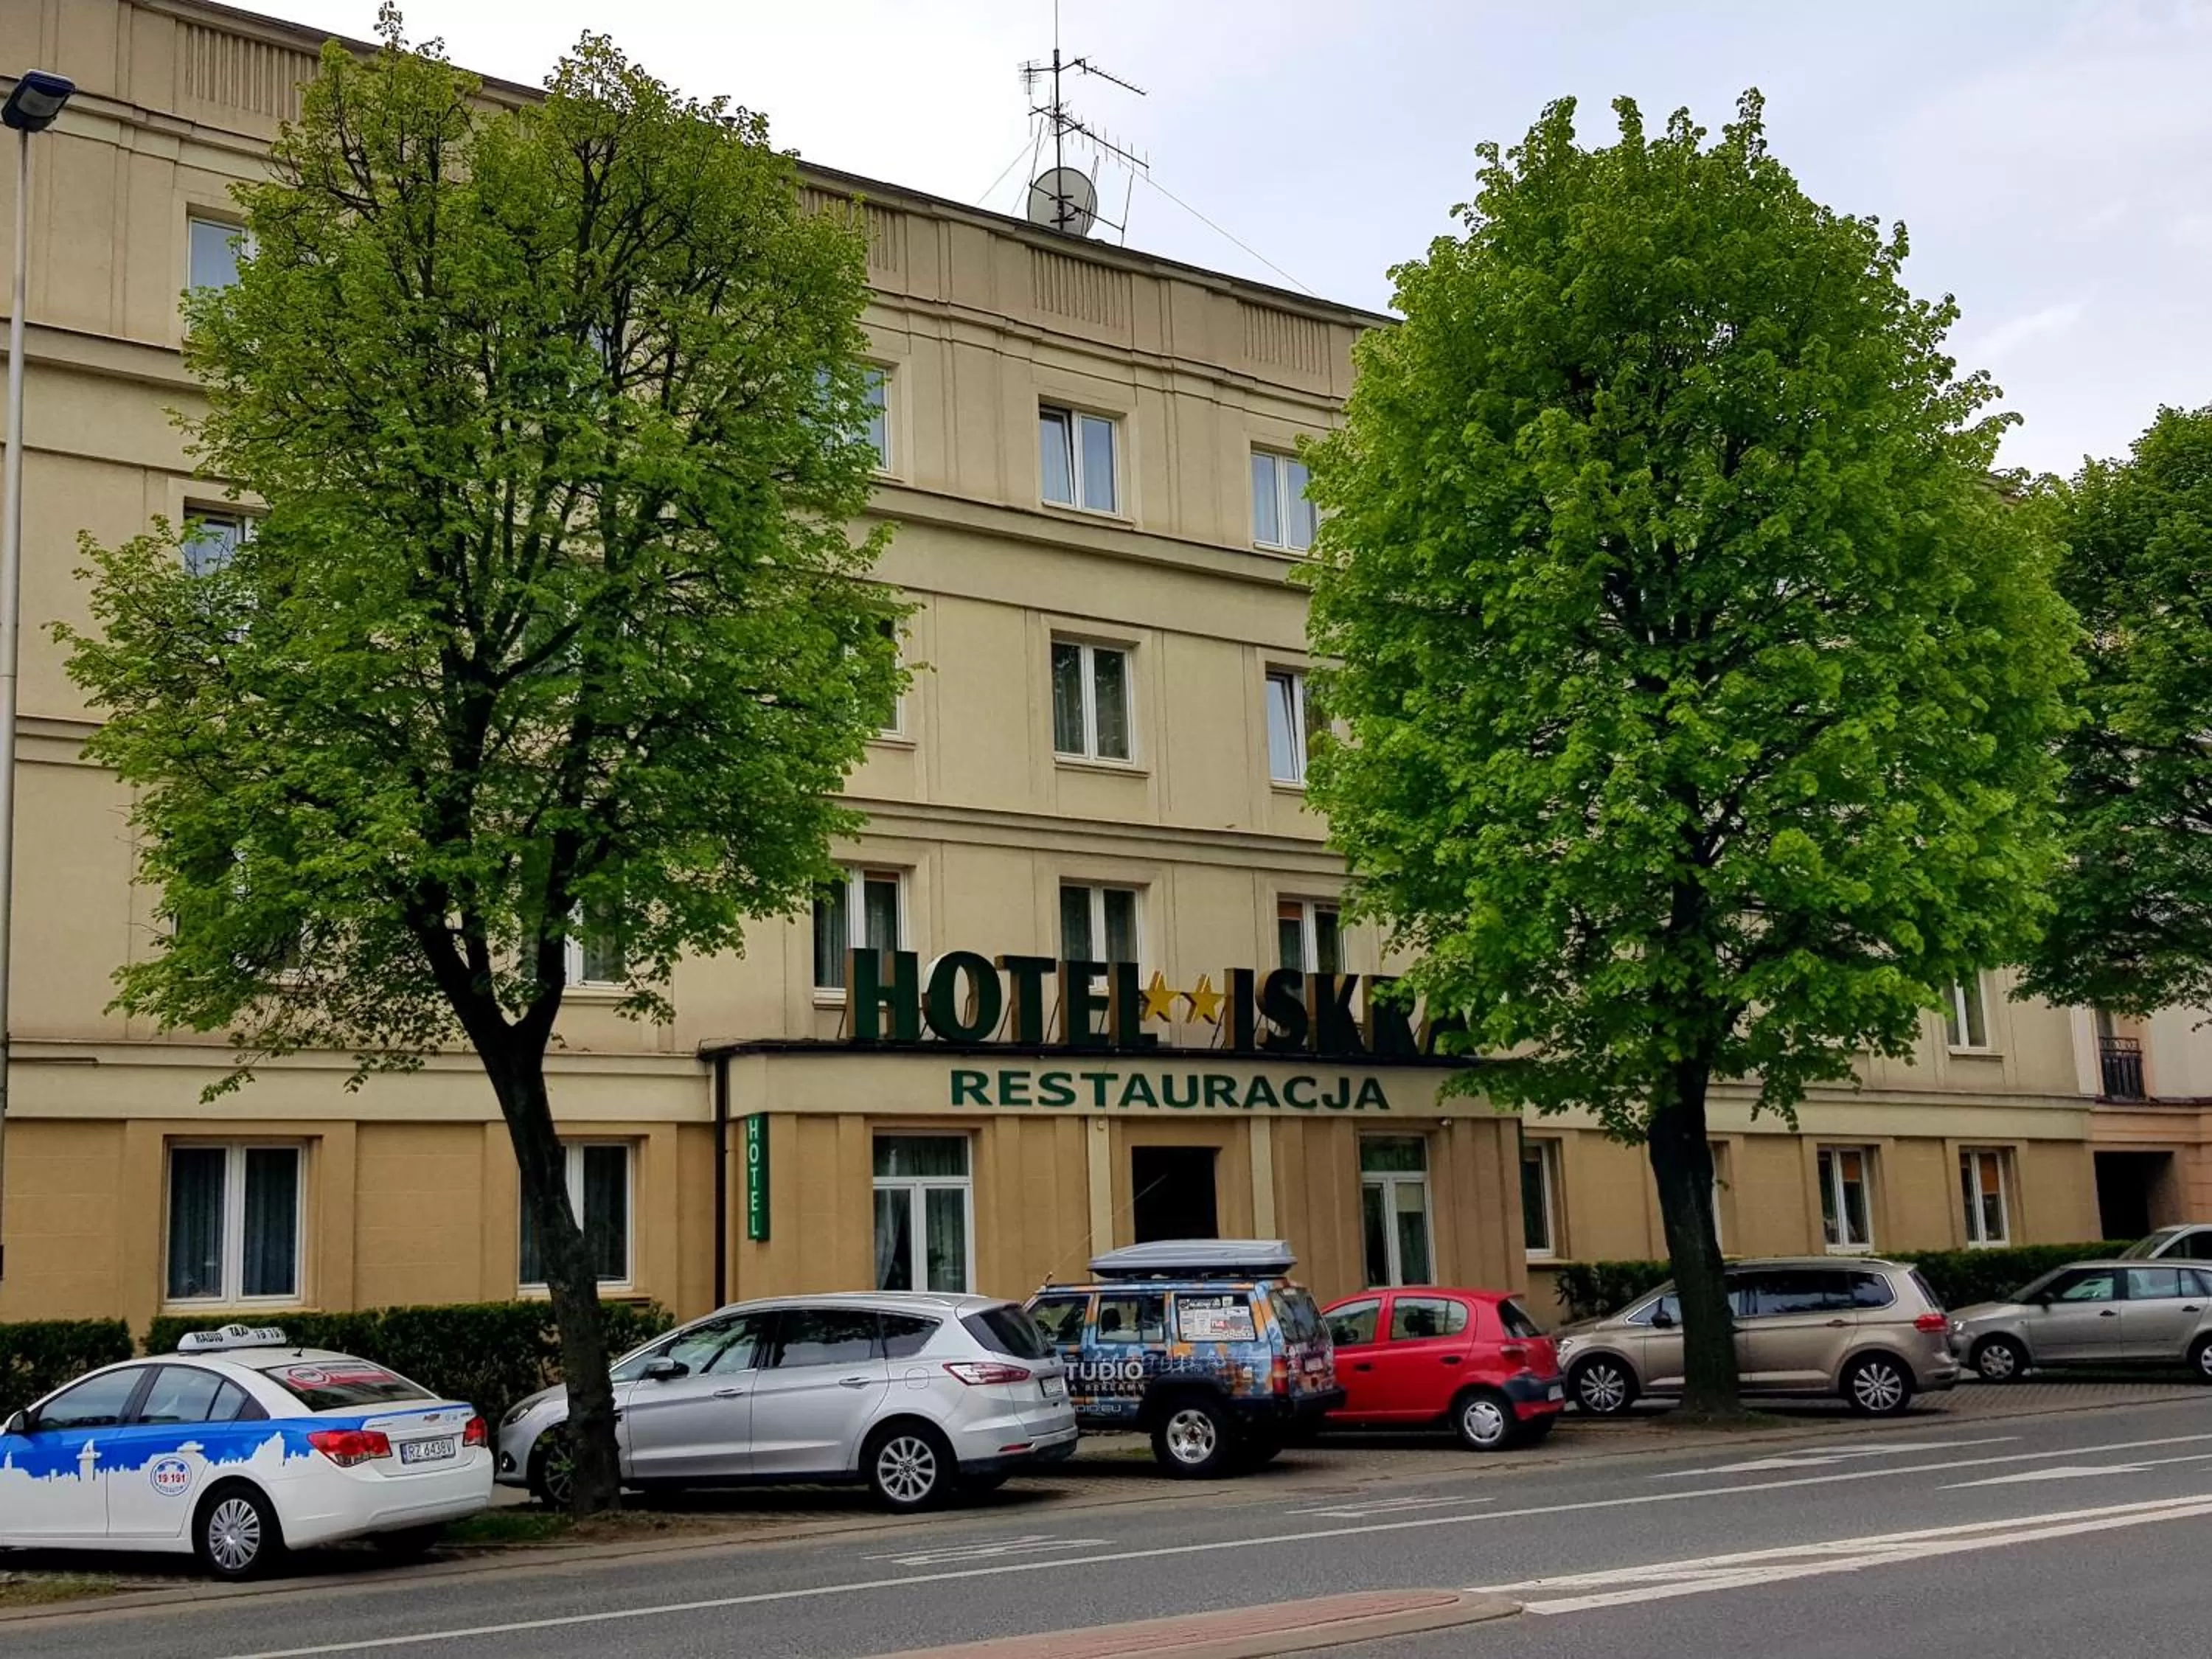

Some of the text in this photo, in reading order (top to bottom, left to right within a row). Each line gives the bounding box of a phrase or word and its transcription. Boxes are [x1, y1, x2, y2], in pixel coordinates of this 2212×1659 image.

[847, 947, 1158, 1046] HOTEL
[950, 1069, 1391, 1110] RESTAURACJA
[748, 1119, 759, 1237] HOTEL
[194, 1332, 223, 1343] RADIO
[229, 1326, 248, 1337] TAXI
[1064, 1362, 1144, 1381] TUDIO
[159, 1473, 185, 1483] 19 191
